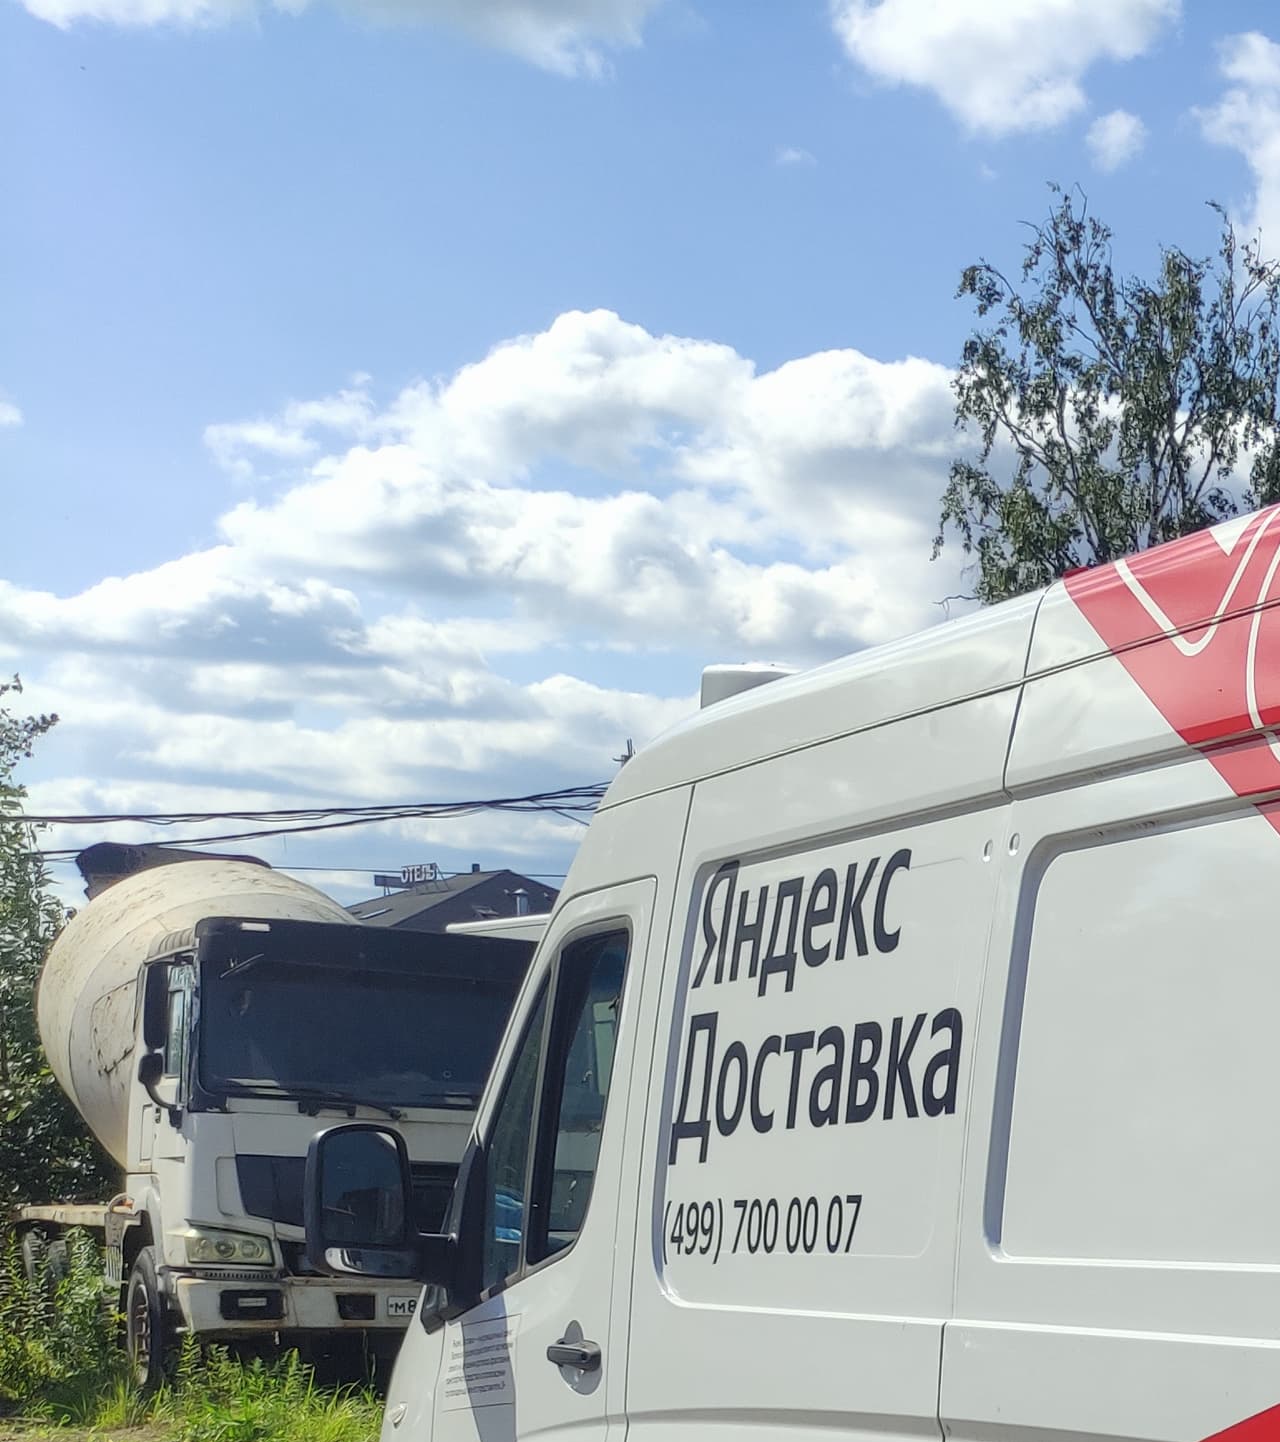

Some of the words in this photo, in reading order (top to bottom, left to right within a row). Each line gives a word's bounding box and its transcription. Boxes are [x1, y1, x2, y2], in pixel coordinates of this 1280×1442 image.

[401, 865, 436, 883] ОТЕЛЬ
[691, 849, 913, 997] Яндекс
[668, 1007, 964, 1166] Доставка
[663, 1198, 724, 1265] (499)
[732, 1198, 779, 1254] 700
[786, 1196, 819, 1254] 00
[826, 1195, 863, 1254] 07
